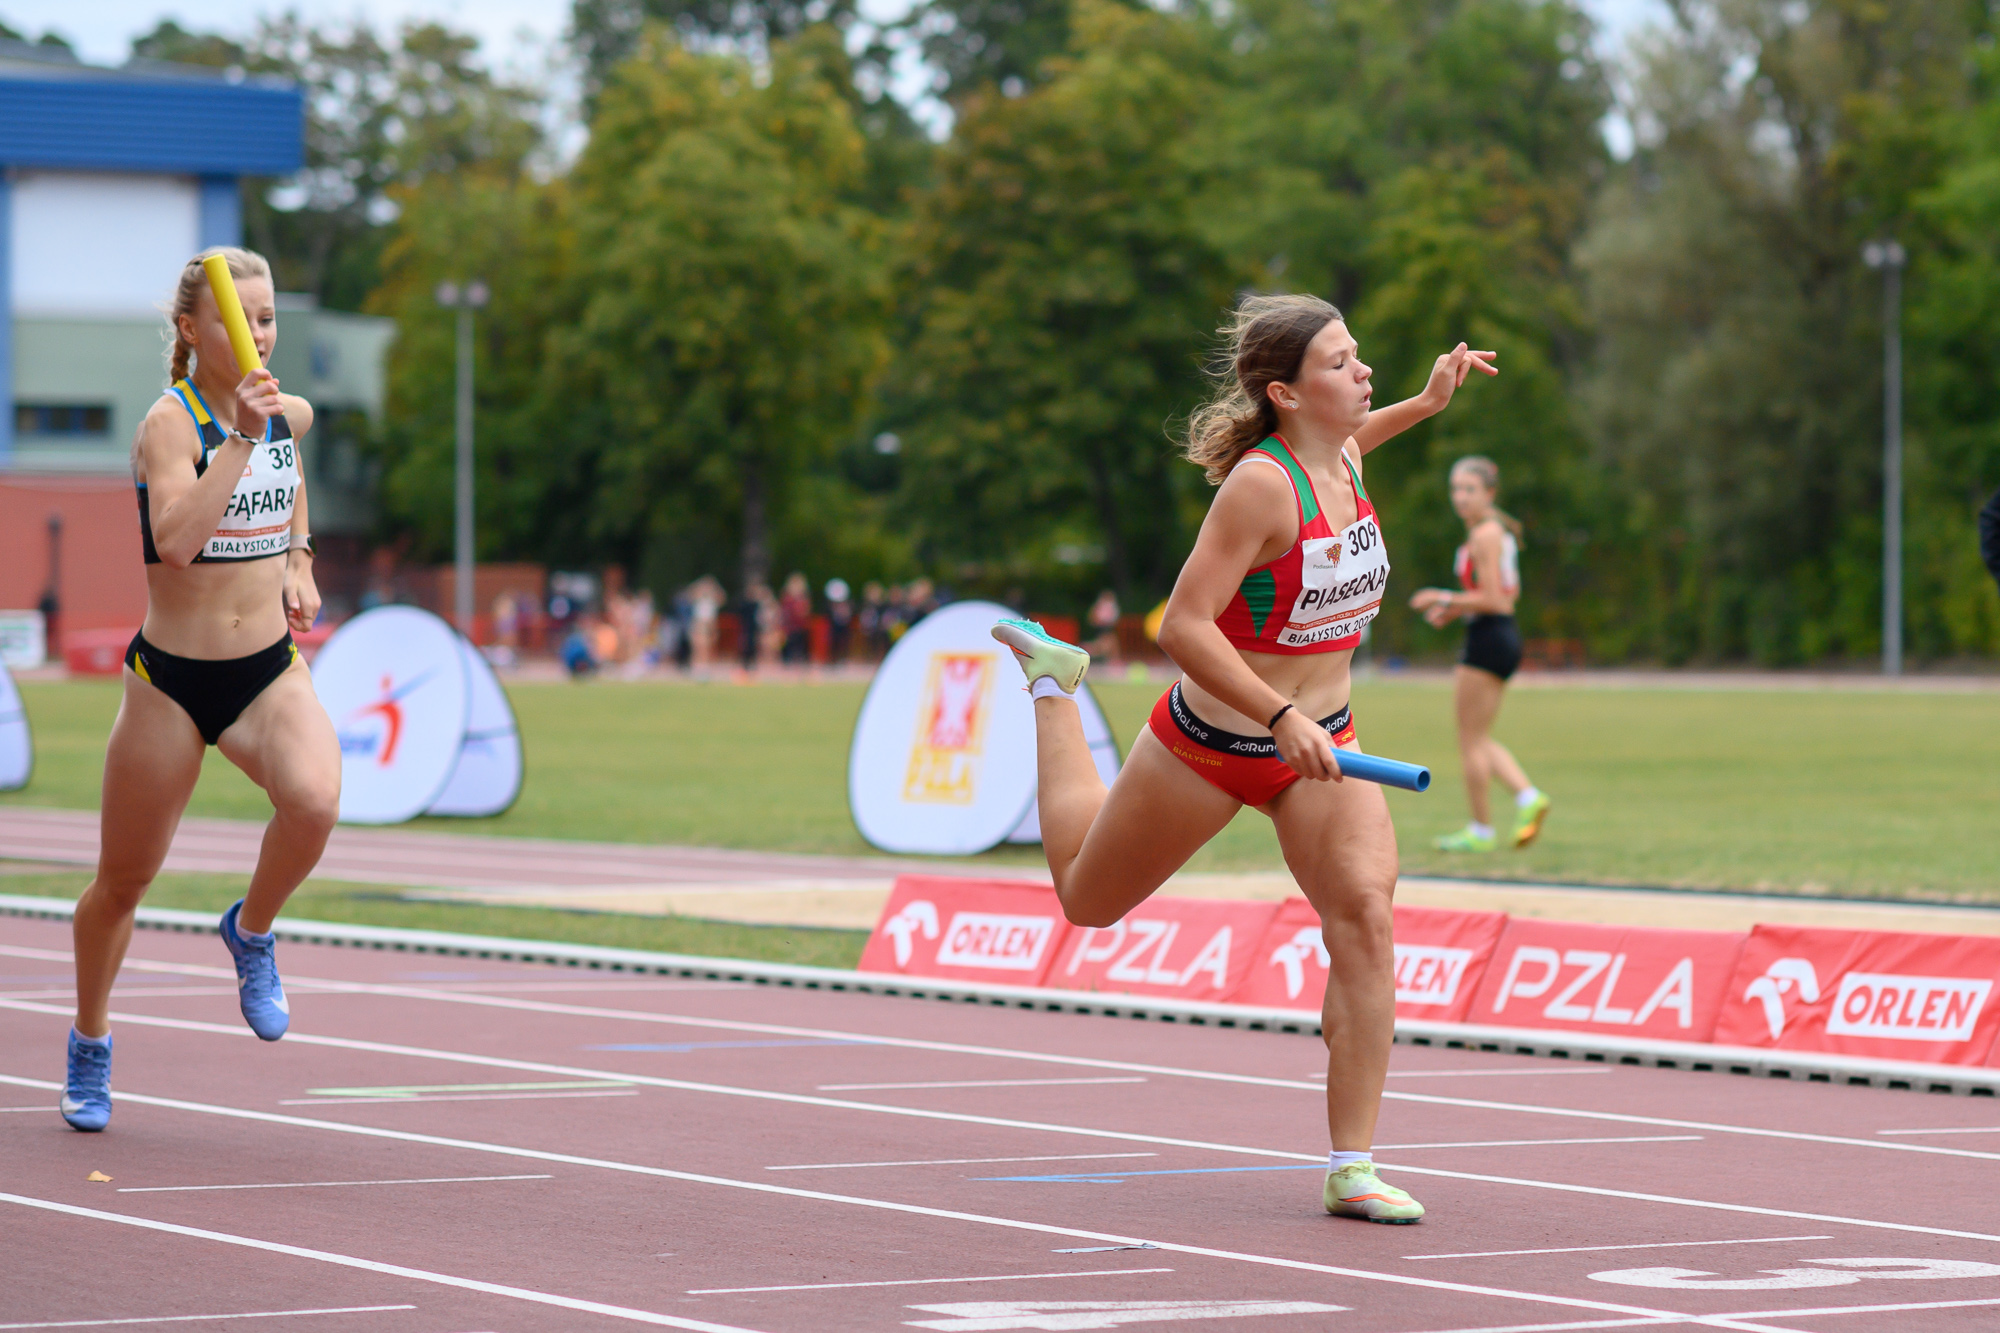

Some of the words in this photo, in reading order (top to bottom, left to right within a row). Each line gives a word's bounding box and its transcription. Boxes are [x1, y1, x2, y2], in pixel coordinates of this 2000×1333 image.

[269, 444, 293, 470] 38
[224, 486, 294, 521] FĄFARA
[212, 538, 276, 553] BIAŁYSTOK
[1348, 521, 1377, 556] 309
[1300, 565, 1386, 611] PIASECKA
[1287, 623, 1351, 643] BIAŁYSTOK
[1172, 745, 1223, 767] BIAŁYSTOK
[952, 923, 1041, 960] ORLEN
[1066, 919, 1233, 989] PZLA
[1394, 955, 1458, 995] LEN
[1492, 945, 1694, 1029] PZLA
[1842, 984, 1978, 1030] ORLEN
